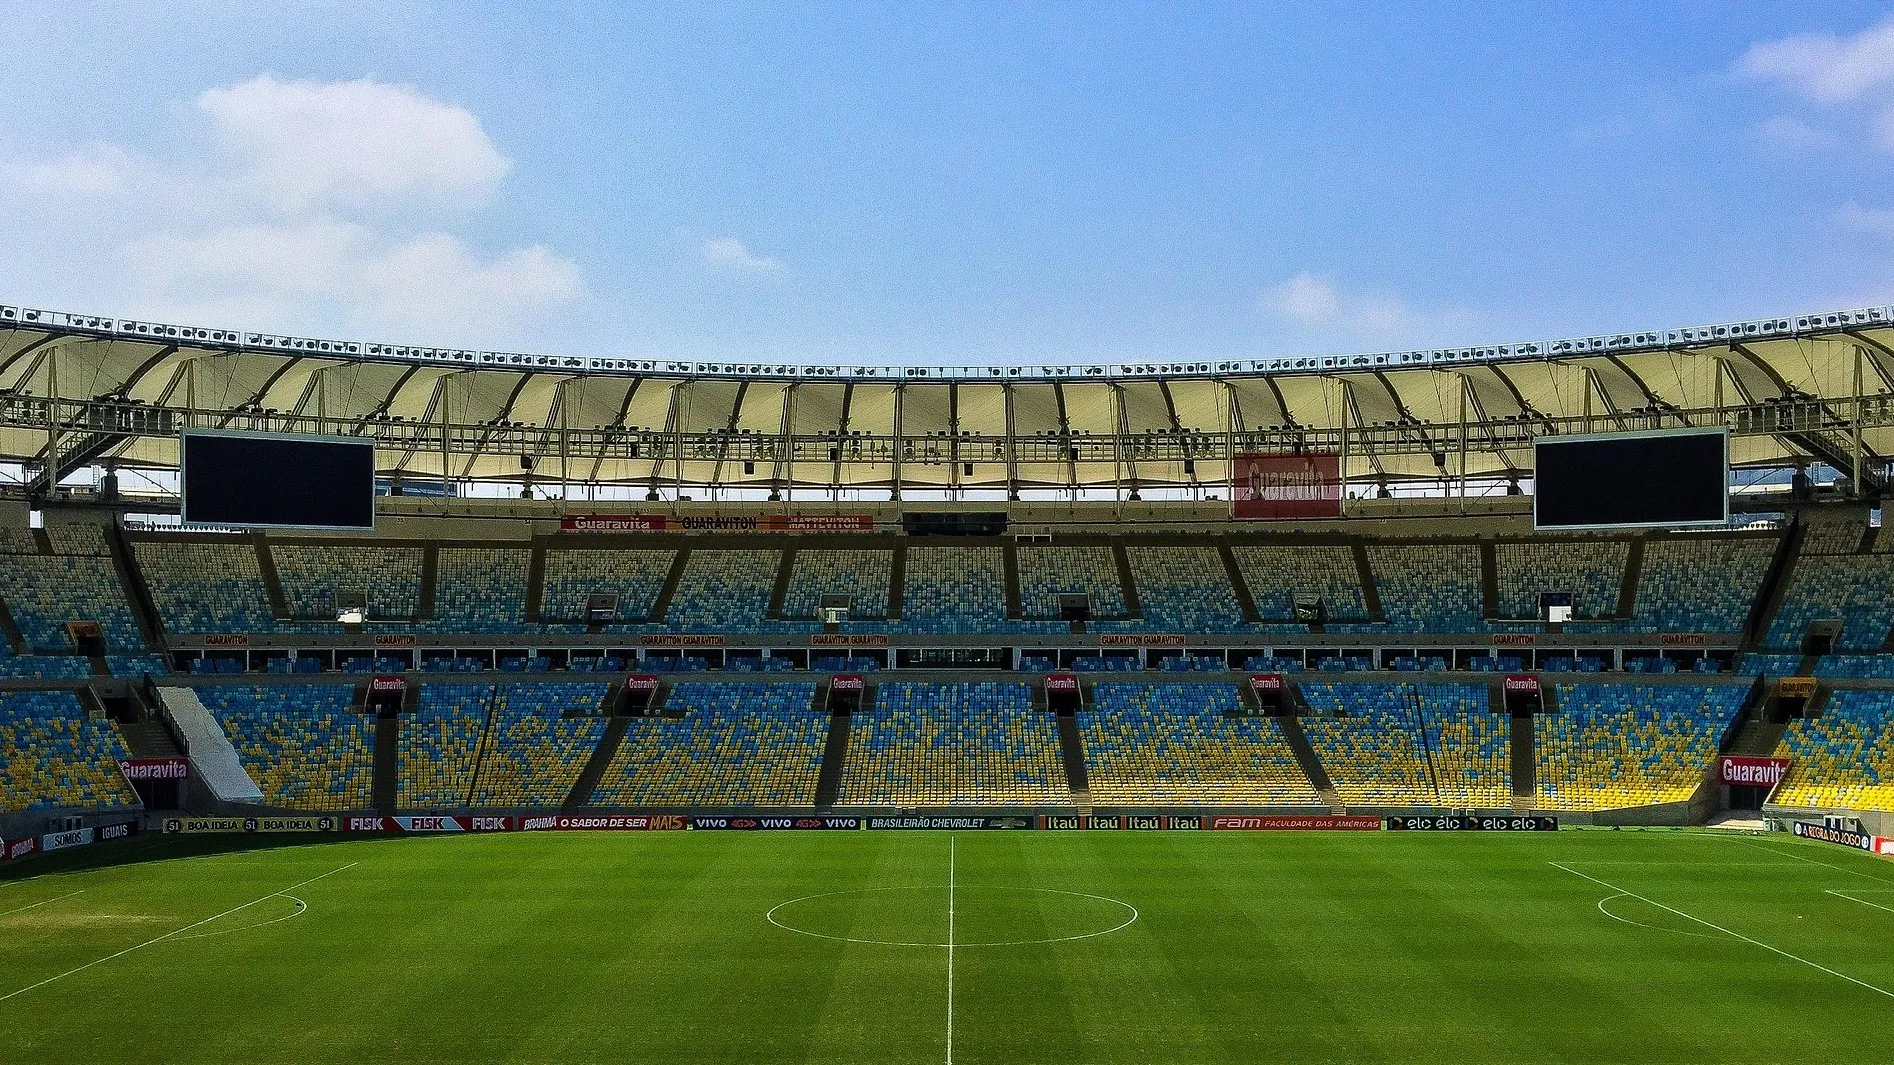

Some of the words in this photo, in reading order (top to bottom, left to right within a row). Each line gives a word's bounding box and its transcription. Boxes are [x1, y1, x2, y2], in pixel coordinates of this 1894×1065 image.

[575, 516, 650, 529] Guaravita
[682, 516, 756, 530] GUARAVITON
[206, 635, 248, 645] GUARAVITON
[376, 634, 415, 644] GUARAVITON
[640, 635, 681, 644] GUARAVITON
[683, 635, 724, 644] GUARAVITON
[812, 635, 850, 644] GUARAVITON
[851, 635, 888, 644] GUARAVITON
[1102, 635, 1142, 644] GUARAVITON
[1144, 635, 1185, 644] GUARAVITON
[1494, 634, 1534, 644] GUARAVITON
[1662, 634, 1704, 644] GUARAVITON
[374, 678, 405, 690] Guaravita
[834, 678, 862, 689] Guaravita
[1046, 677, 1075, 688] Guaravita
[1506, 678, 1537, 689] Guaravita
[120, 760, 187, 778] Guaravita
[168, 821, 180, 831] 51
[188, 821, 210, 830] BOA
[212, 821, 238, 830] IDEIA
[245, 821, 256, 830] 51
[263, 820, 286, 830] BOA
[287, 820, 312, 829] IDEIA
[319, 820, 330, 829] 51
[350, 817, 384, 830] FISK
[411, 817, 445, 830] FISK
[472, 817, 505, 830] FISK
[524, 816, 557, 830] BRAHMA
[561, 818, 568, 827] O
[570, 818, 607, 827] SABOR
[609, 818, 624, 827] DE
[625, 818, 647, 827] SER
[696, 819, 727, 828] VIVO
[761, 819, 792, 828] VIVO
[826, 819, 856, 828] VIVO
[872, 816, 930, 828] BRASILEIRÃO
[931, 818, 985, 827] CHEVROLET
[1048, 817, 1078, 829] Itaú
[1088, 817, 1118, 829] Itaú
[1129, 817, 1159, 829] Itaú
[1169, 817, 1199, 829] Itaú
[1335, 819, 1379, 828] AMÉRICAS
[102, 824, 128, 839] IGUAIS
[54, 832, 82, 846] SOMOS
[1840, 833, 1860, 846] JOGO
